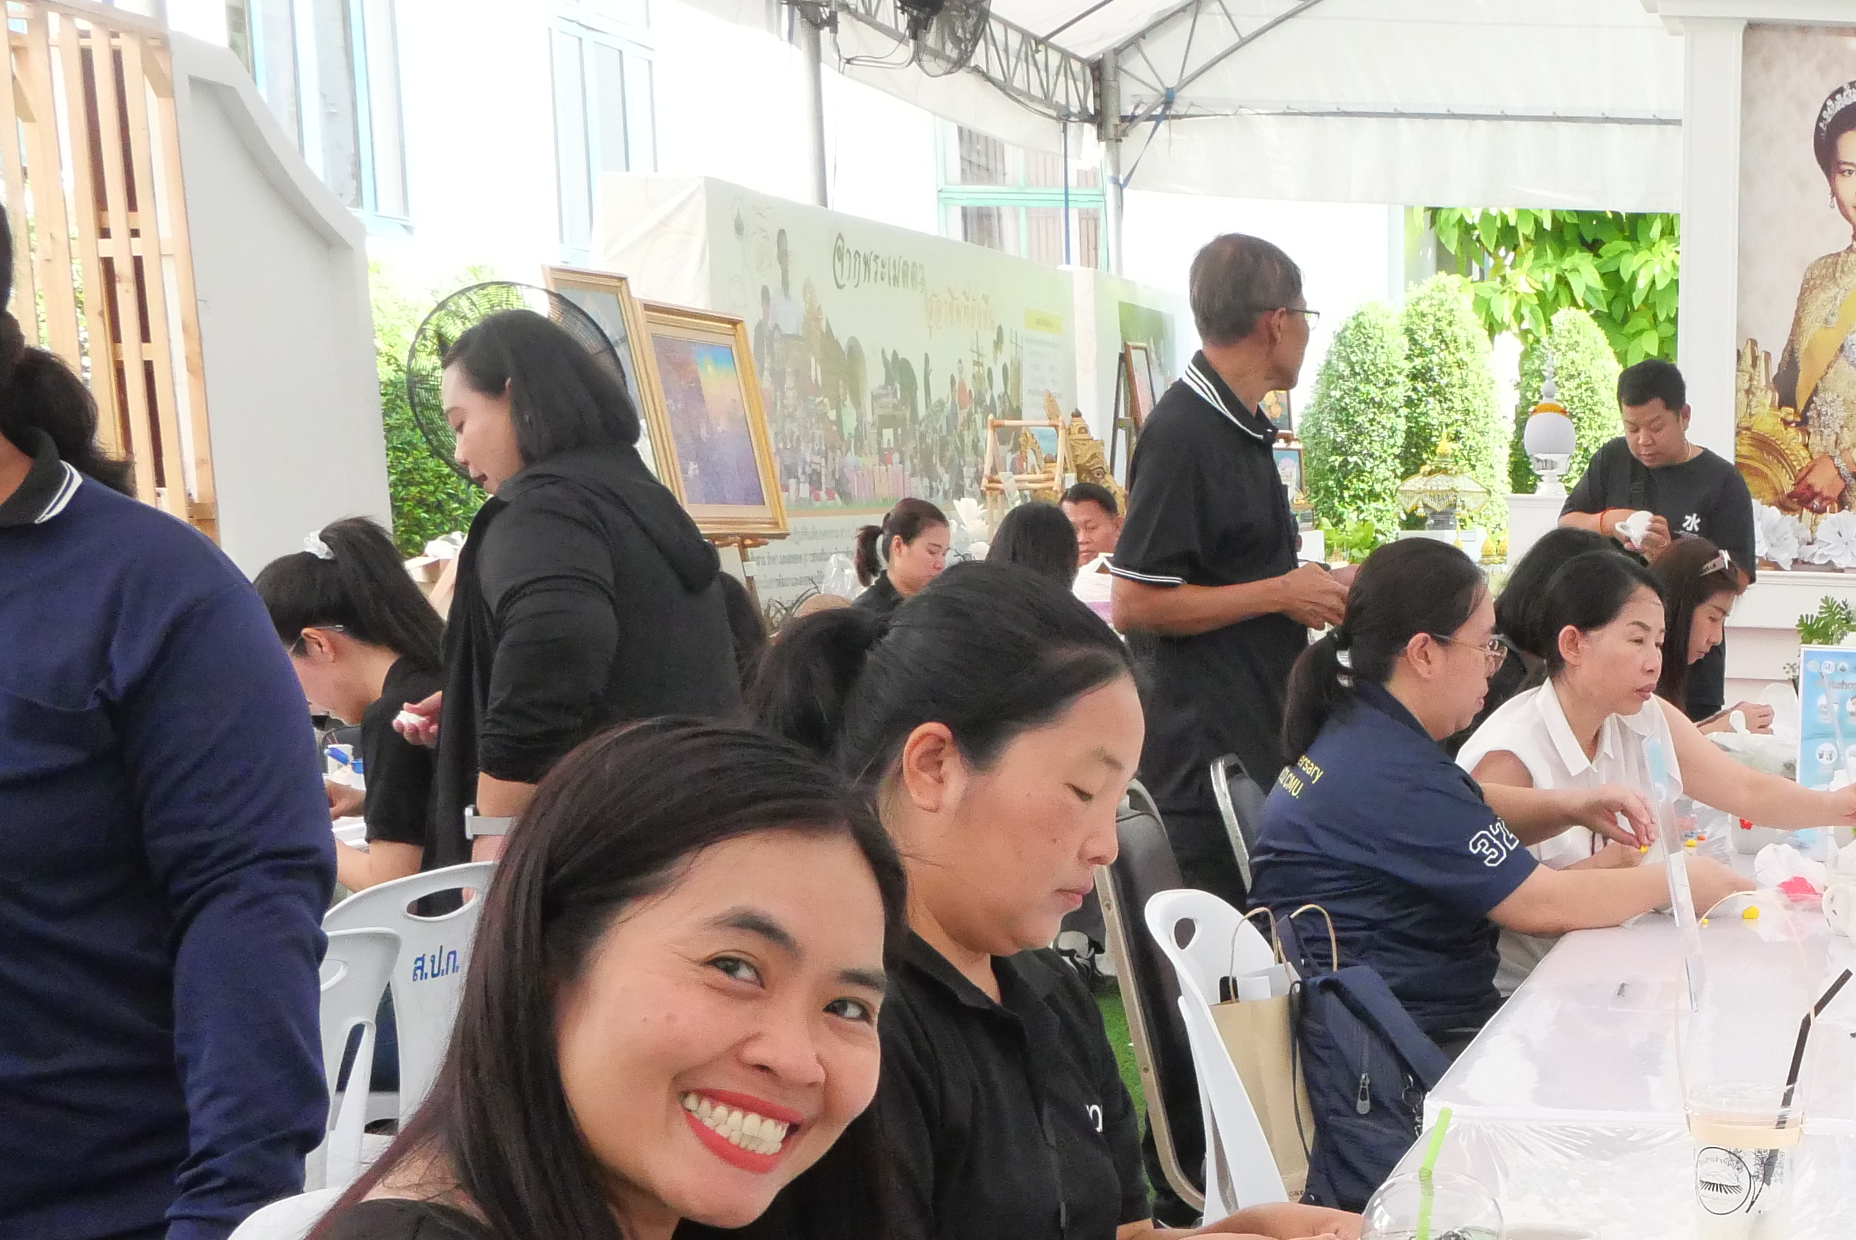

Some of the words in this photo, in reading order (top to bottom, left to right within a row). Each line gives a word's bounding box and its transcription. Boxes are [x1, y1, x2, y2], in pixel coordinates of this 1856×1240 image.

[1682, 513, 1701, 532] 水
[1469, 818, 1519, 867] 32
[412, 945, 460, 982] ส.ป.ก.
